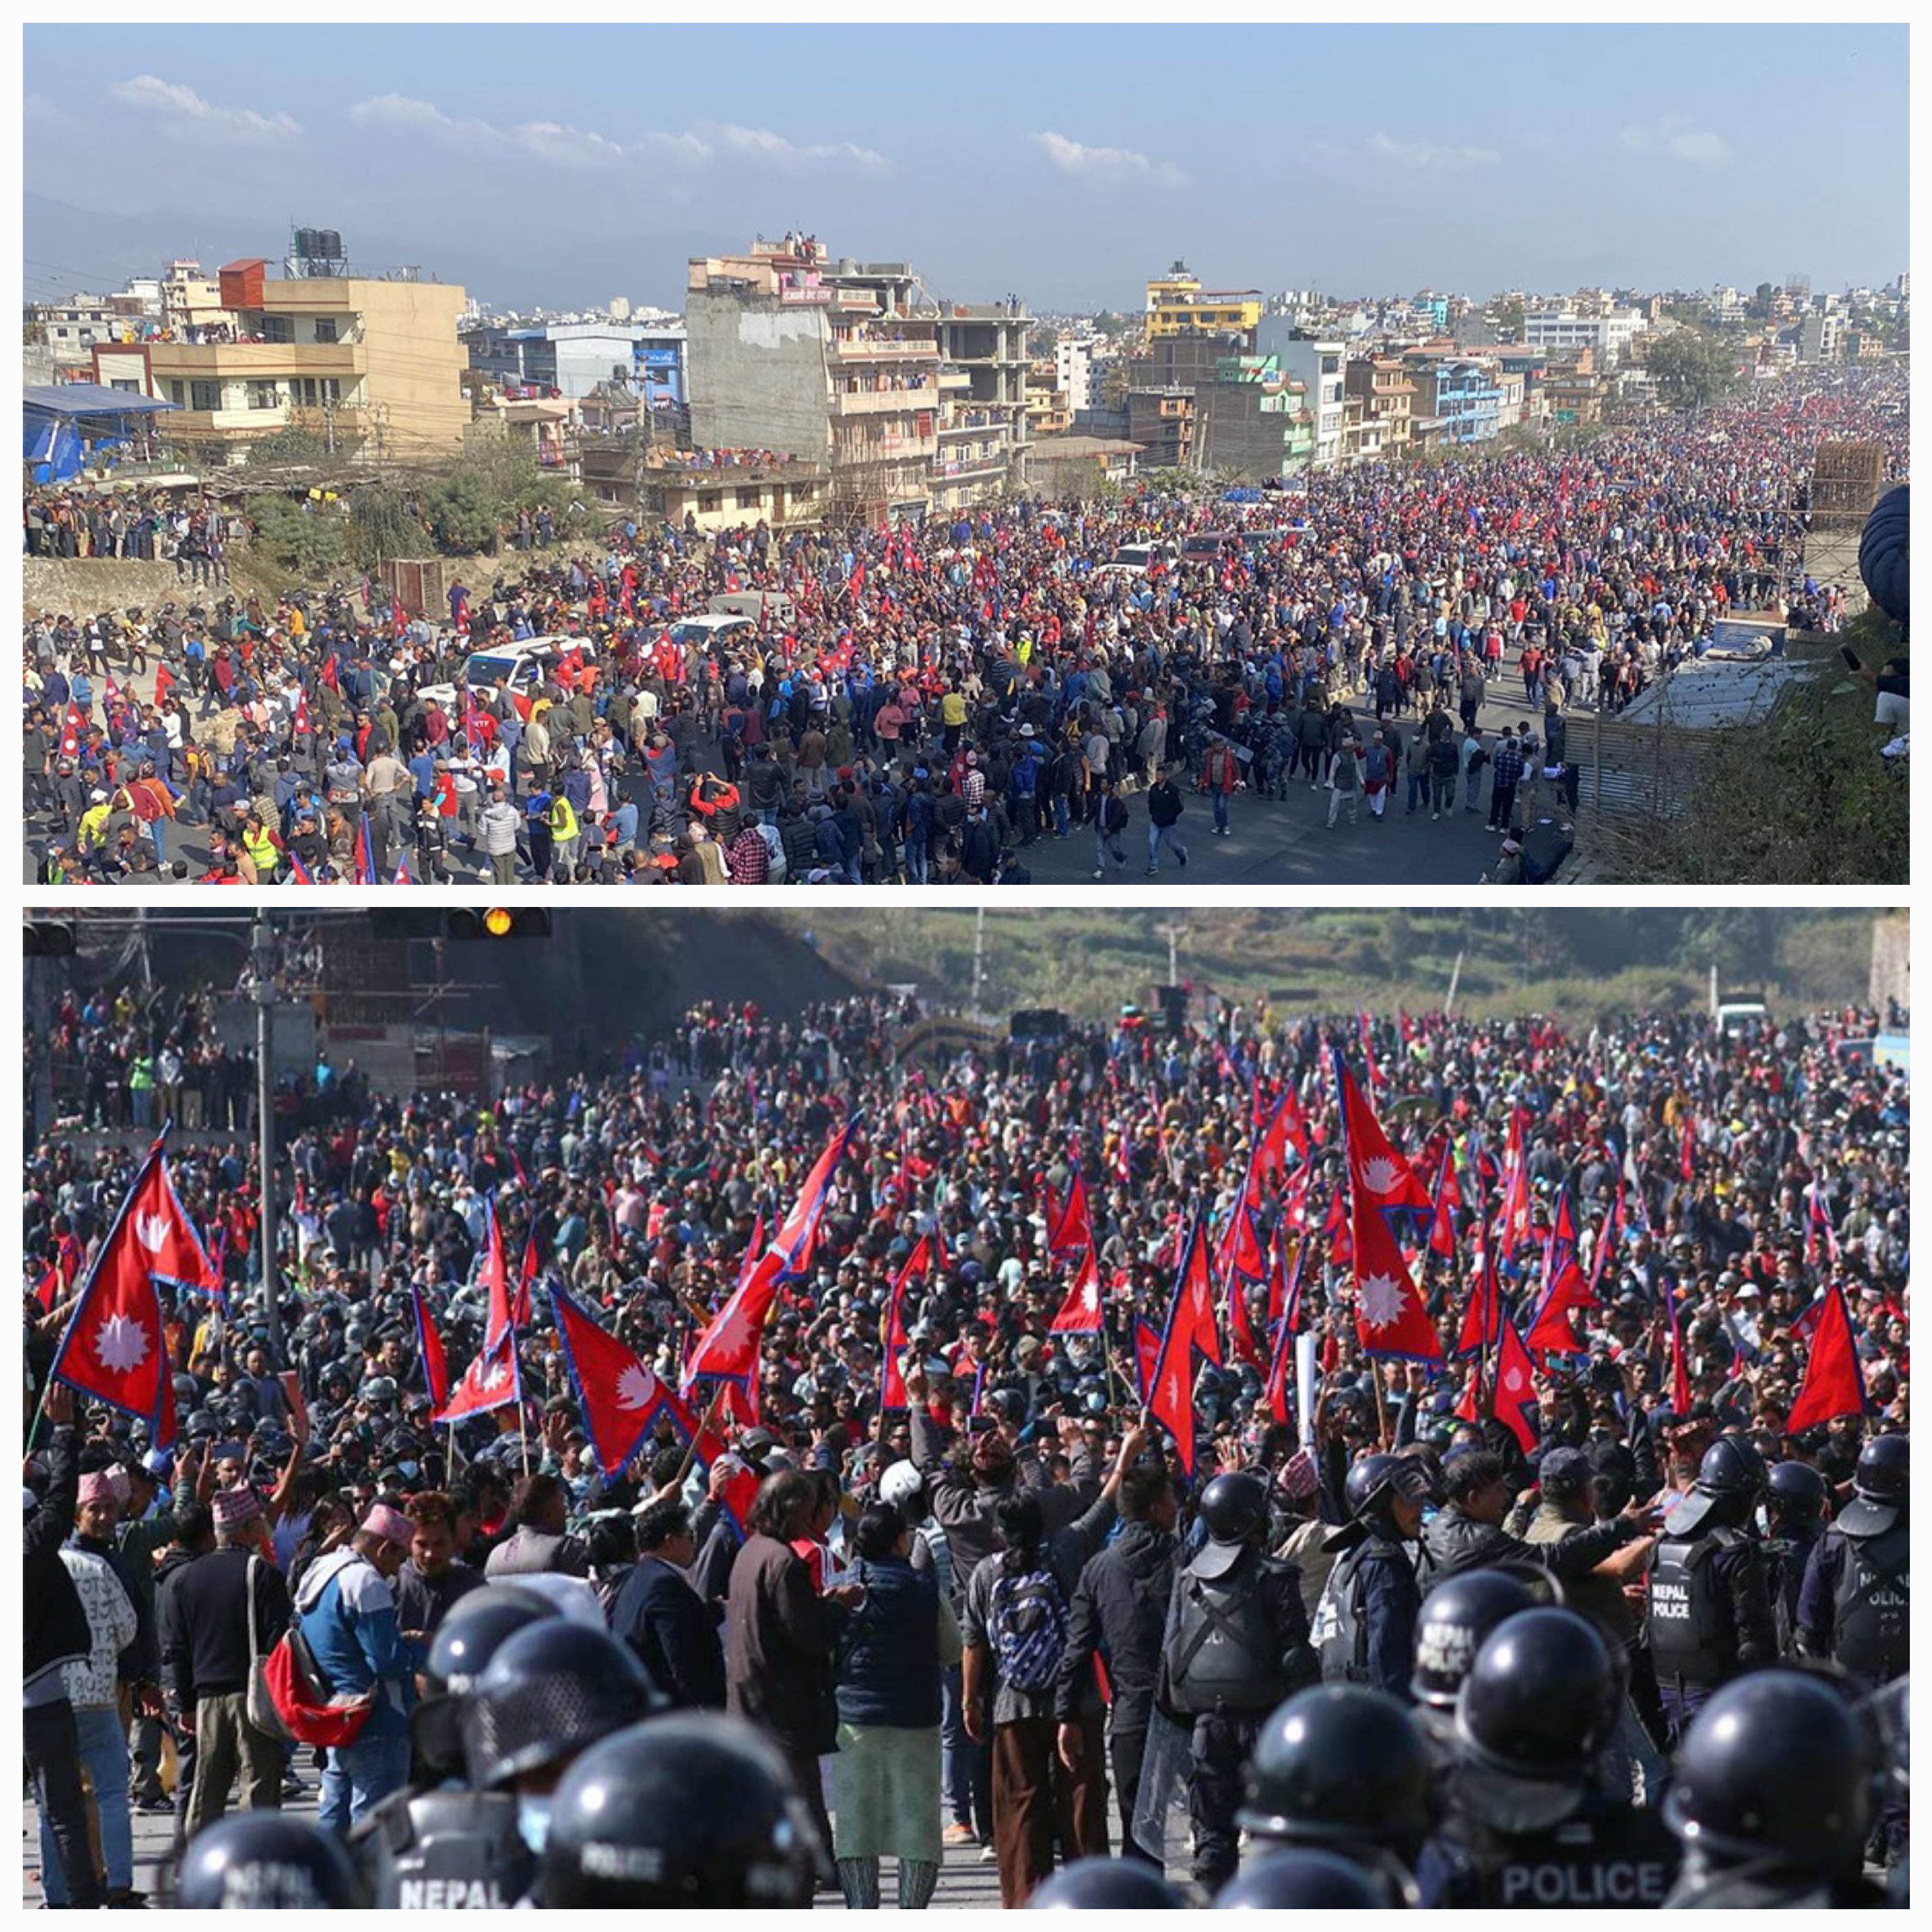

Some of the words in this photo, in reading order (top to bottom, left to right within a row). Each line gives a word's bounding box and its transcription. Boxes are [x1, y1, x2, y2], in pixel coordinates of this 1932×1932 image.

[1652, 1584, 1688, 1601] NEPAL
[1654, 1601, 1690, 1619] POLICE
[400, 1879, 509, 1909] NEPAL
[1502, 1862, 1664, 1904] POLICE
